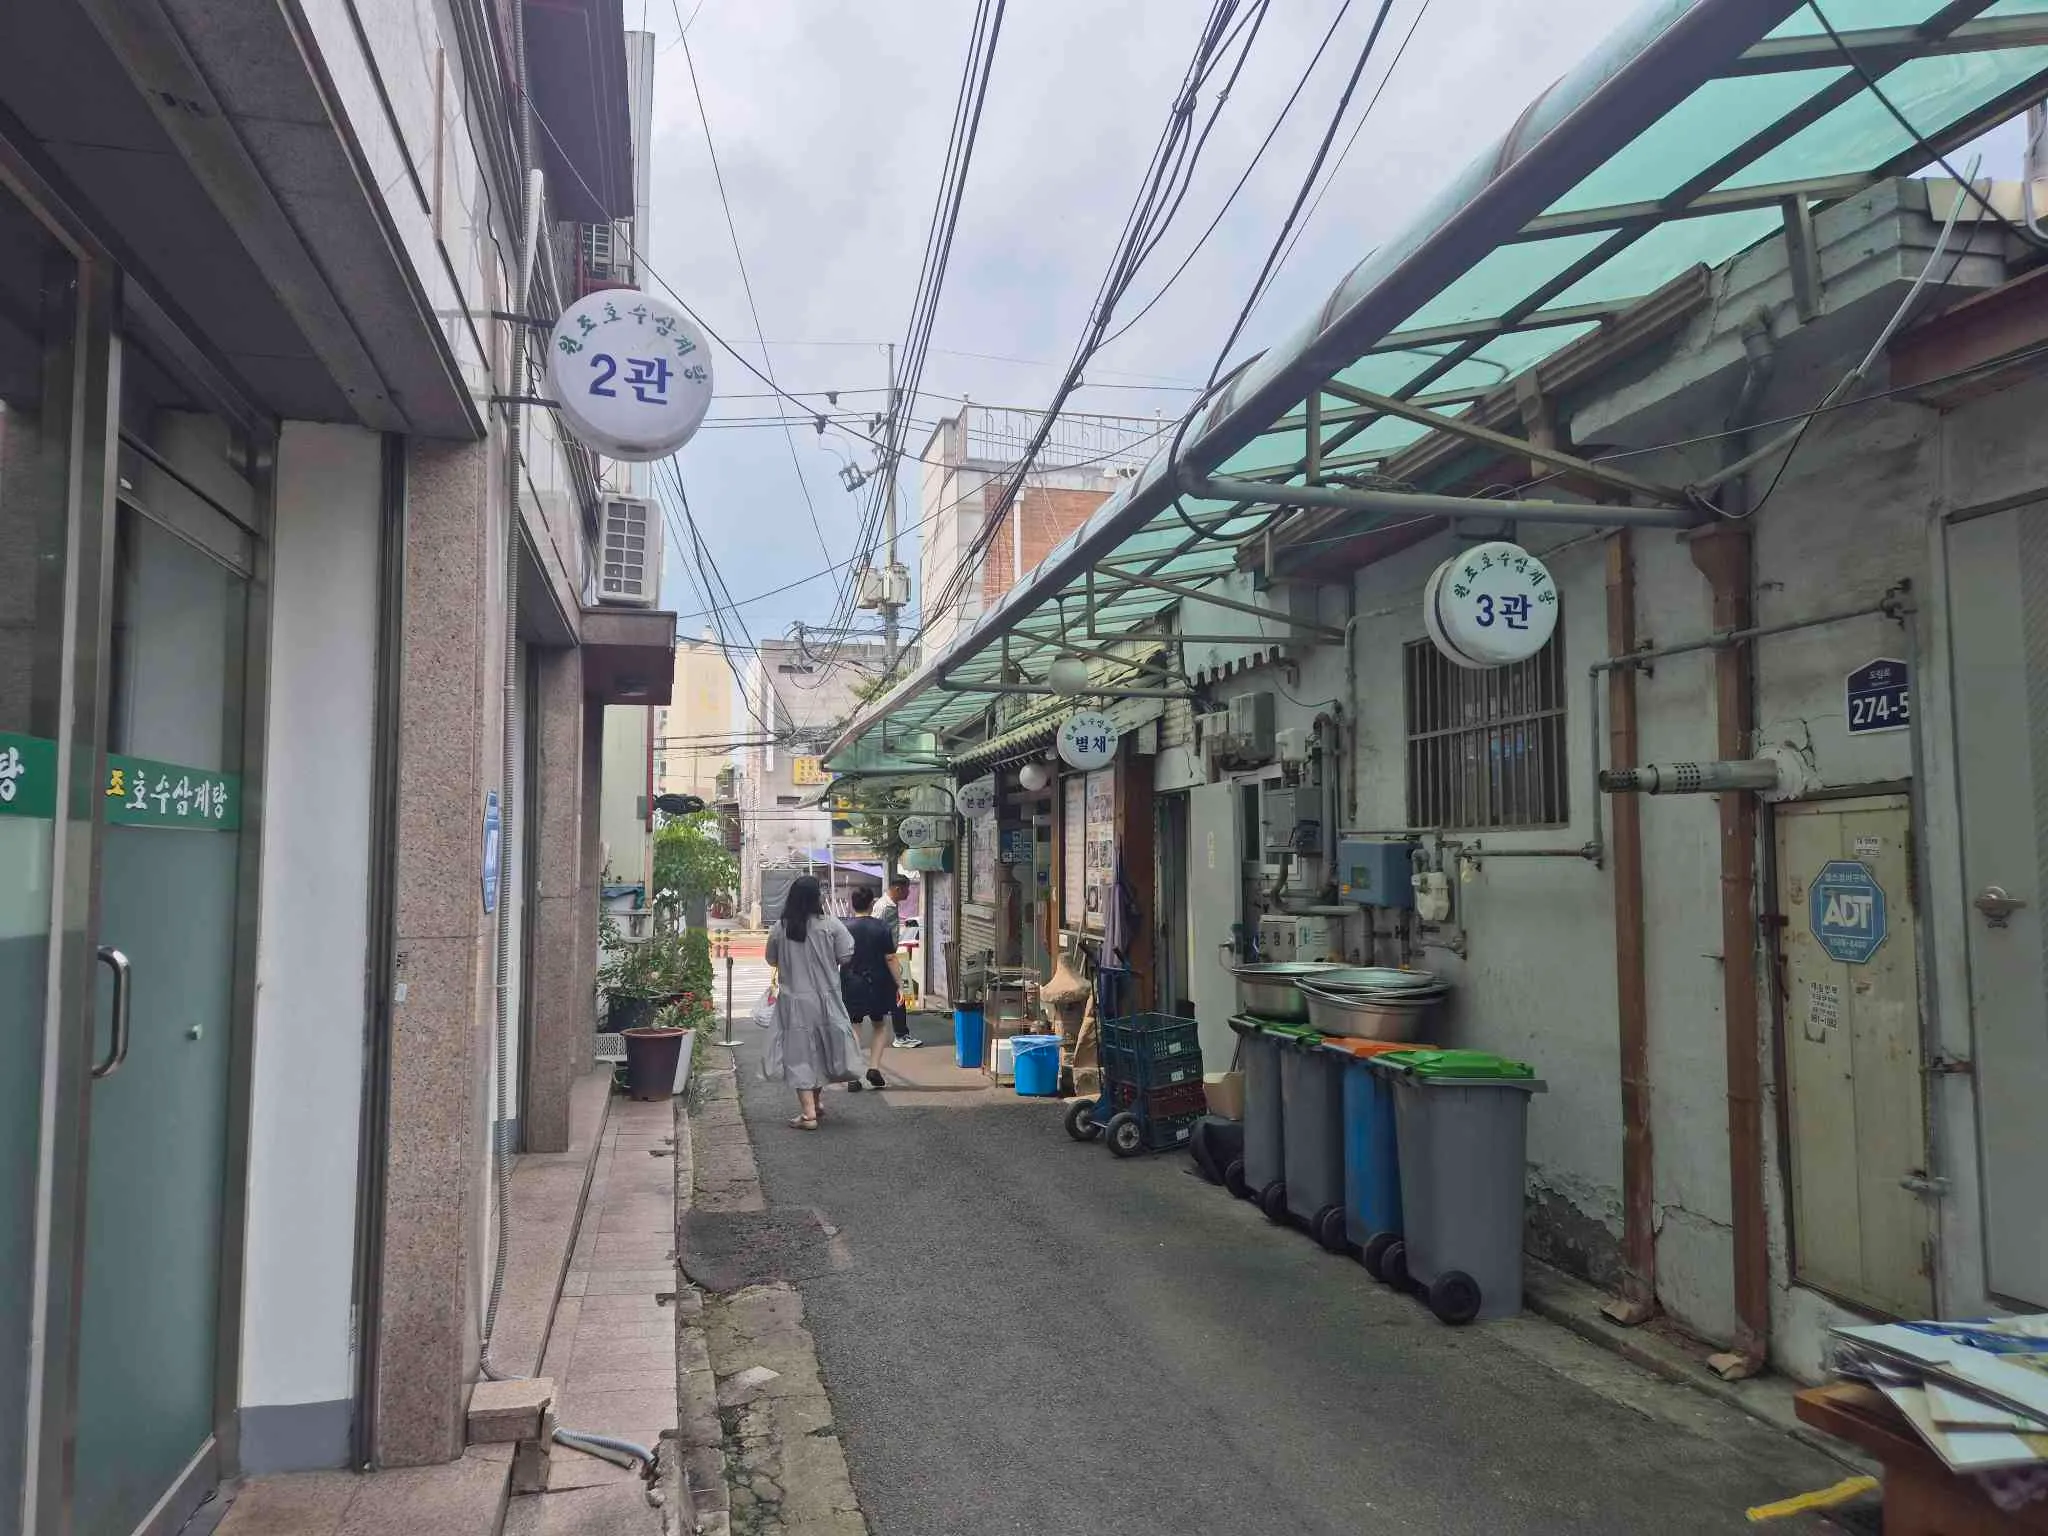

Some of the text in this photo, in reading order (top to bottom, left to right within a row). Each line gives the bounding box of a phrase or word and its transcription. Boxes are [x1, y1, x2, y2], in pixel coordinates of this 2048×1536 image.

[589, 353, 674, 405] 2관
[1475, 594, 1533, 629] 3관
[1075, 735, 1106, 753] 별채
[1823, 894, 1873, 929] ADT
